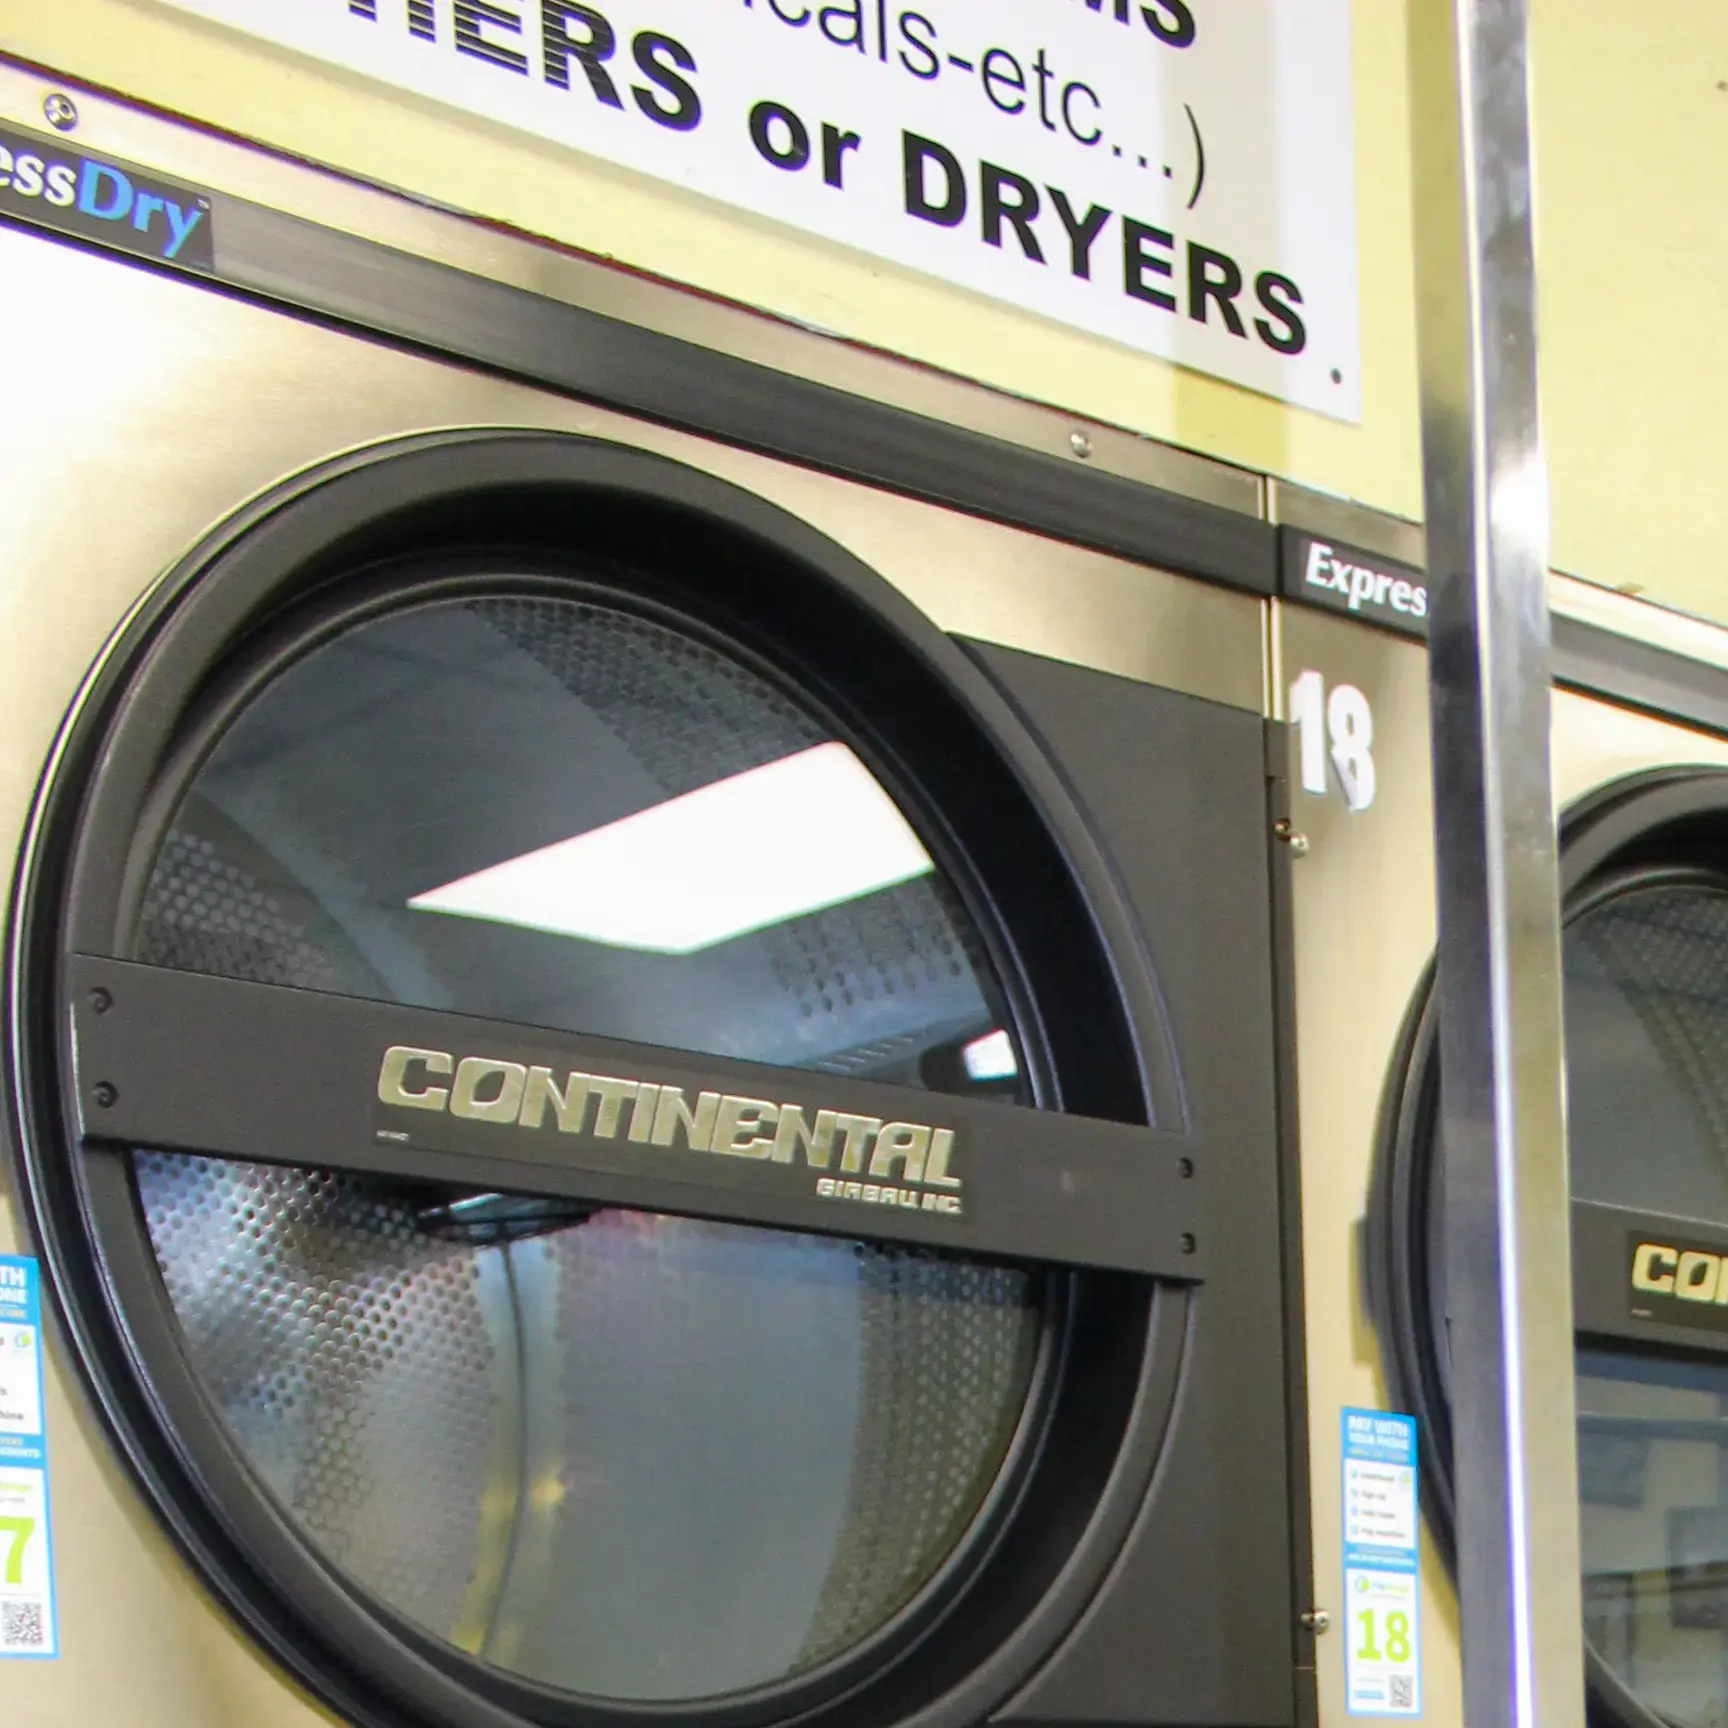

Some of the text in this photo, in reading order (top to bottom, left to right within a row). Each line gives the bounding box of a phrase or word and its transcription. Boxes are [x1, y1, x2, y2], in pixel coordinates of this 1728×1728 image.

[348, 0, 1308, 355] ERS or DRYERS
[1289, 670, 1376, 812] 18
[376, 1045, 964, 1189] CONTINENTAL
[1356, 1608, 1411, 1664] 18
